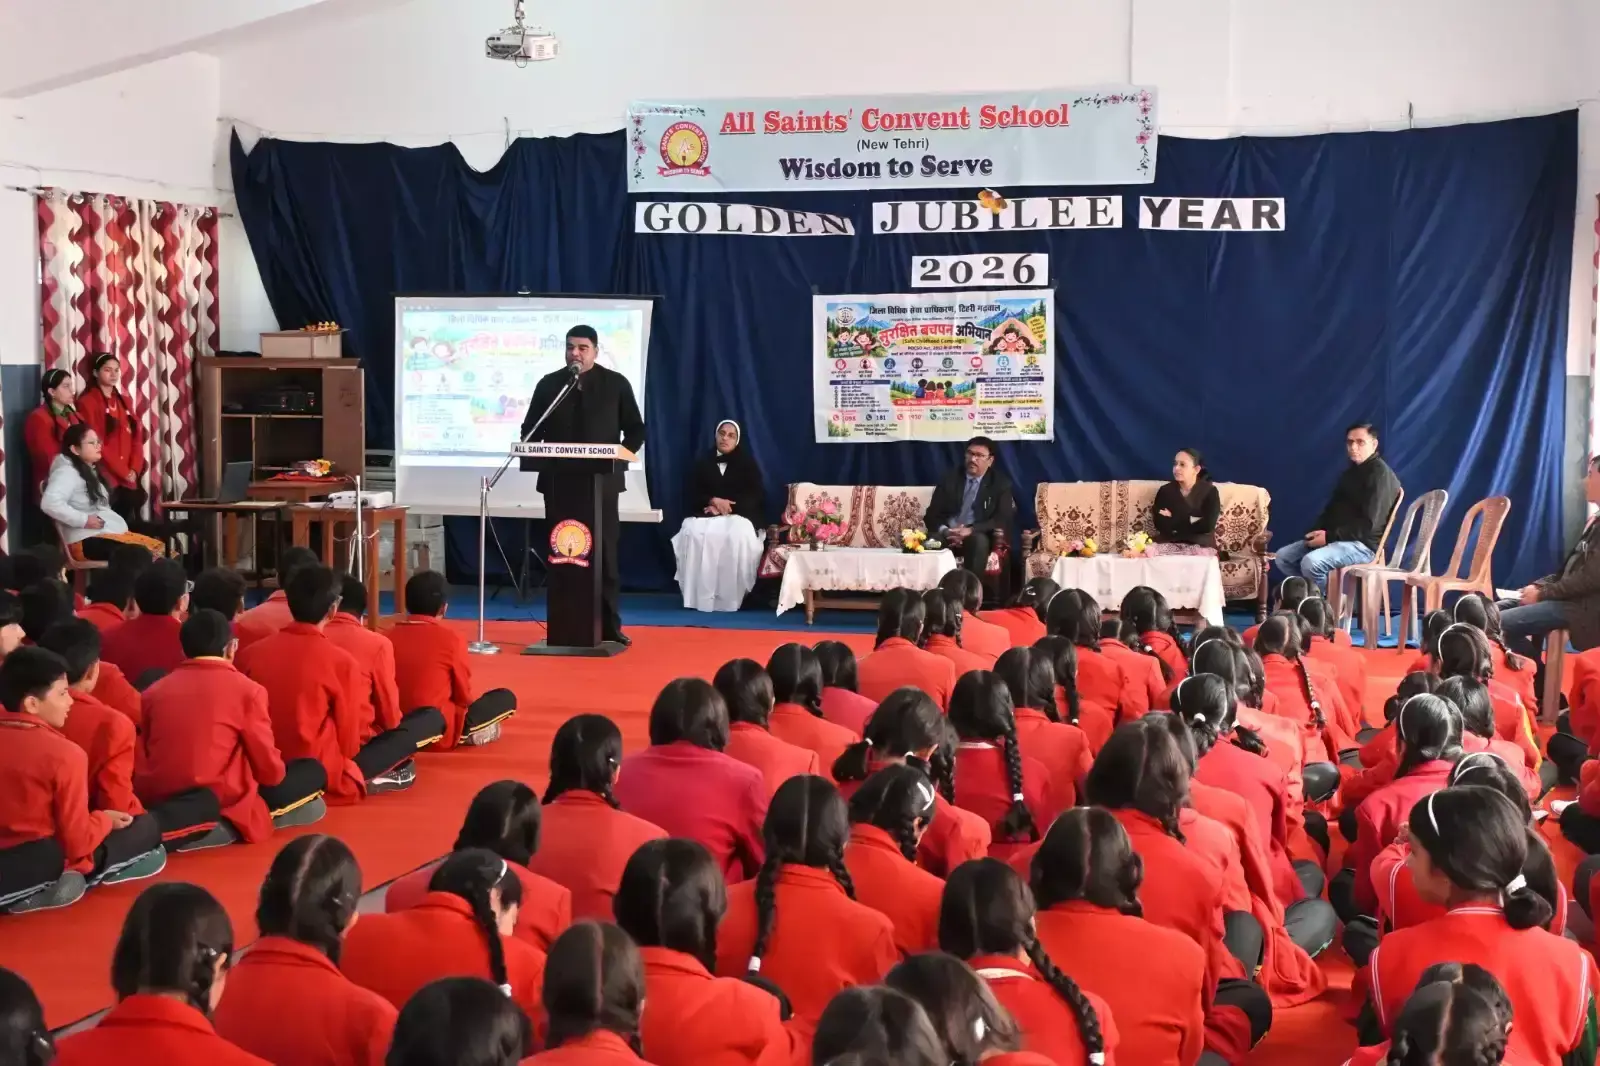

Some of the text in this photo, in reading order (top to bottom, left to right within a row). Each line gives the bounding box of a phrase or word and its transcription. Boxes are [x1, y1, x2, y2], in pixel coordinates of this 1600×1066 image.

[720, 103, 1070, 134] All Saints' Convent School
[857, 137, 929, 152] (New Tehri)
[779, 154, 993, 180] Wisdom to Serve
[643, 196, 1281, 234] GOLDEN JUBILEE YEAR
[919, 254, 1036, 284] 2026
[879, 321, 993, 347] सुरक्षित बचपन अभियान
[514, 445, 616, 455] ALL SAINTS' CONVENT SCHOOL
